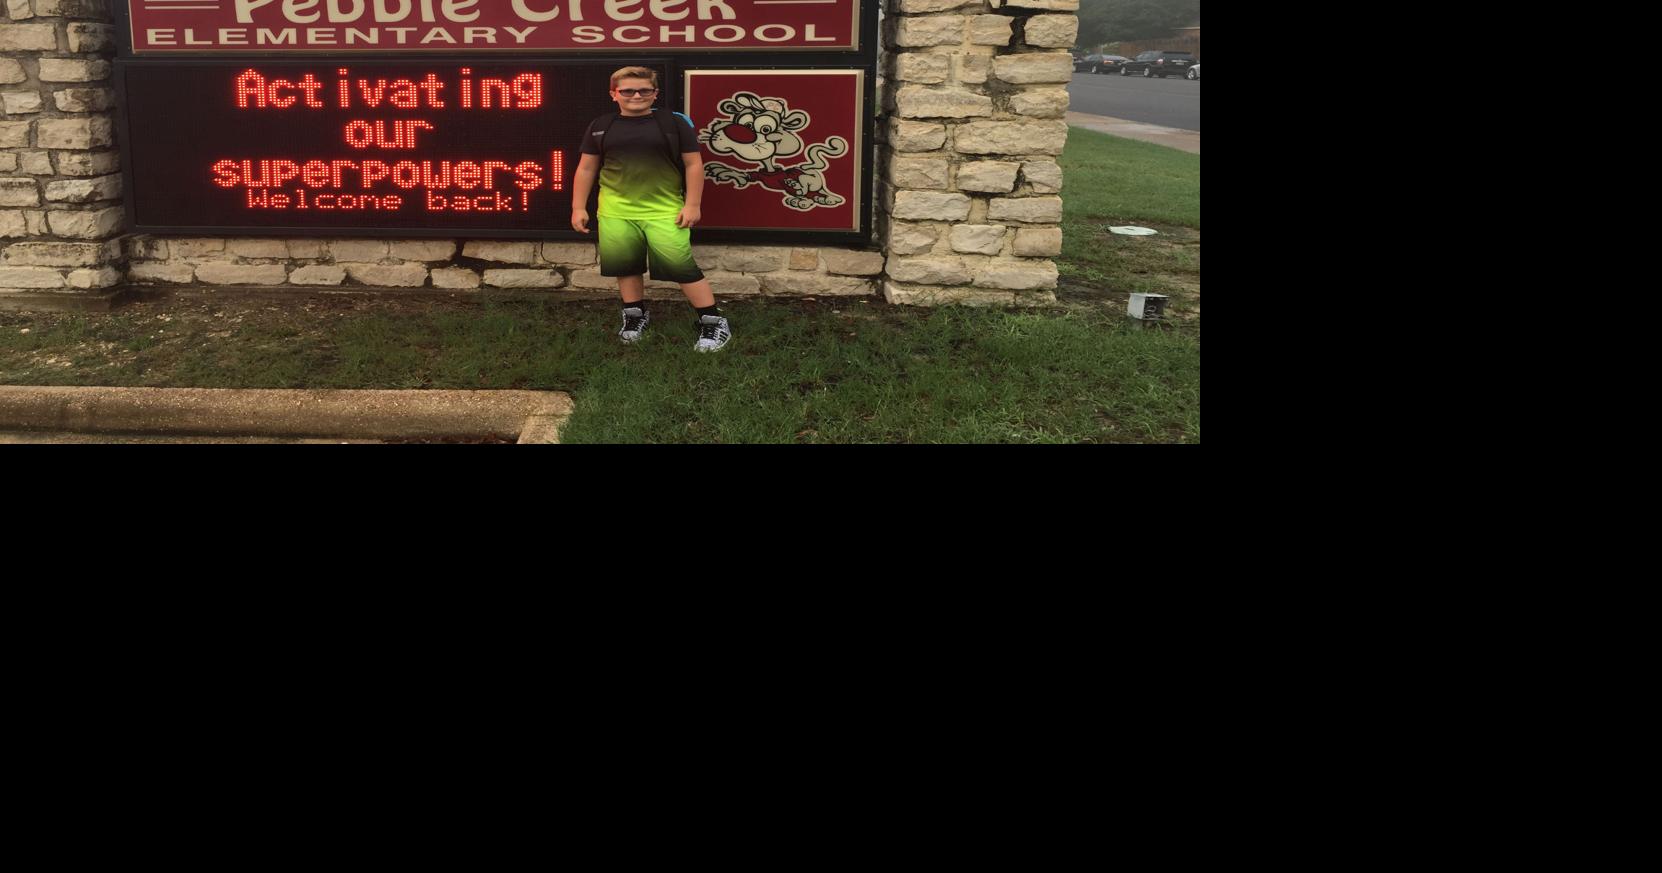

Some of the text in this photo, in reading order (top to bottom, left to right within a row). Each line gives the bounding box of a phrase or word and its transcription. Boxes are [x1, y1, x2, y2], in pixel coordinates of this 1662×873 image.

[146, 24, 836, 45] ELEMENTARY SCHOOL
[235, 68, 543, 109] Activating
[344, 119, 434, 149] our
[212, 150, 564, 190] superpowers!
[247, 188, 530, 212] Welcome back!
